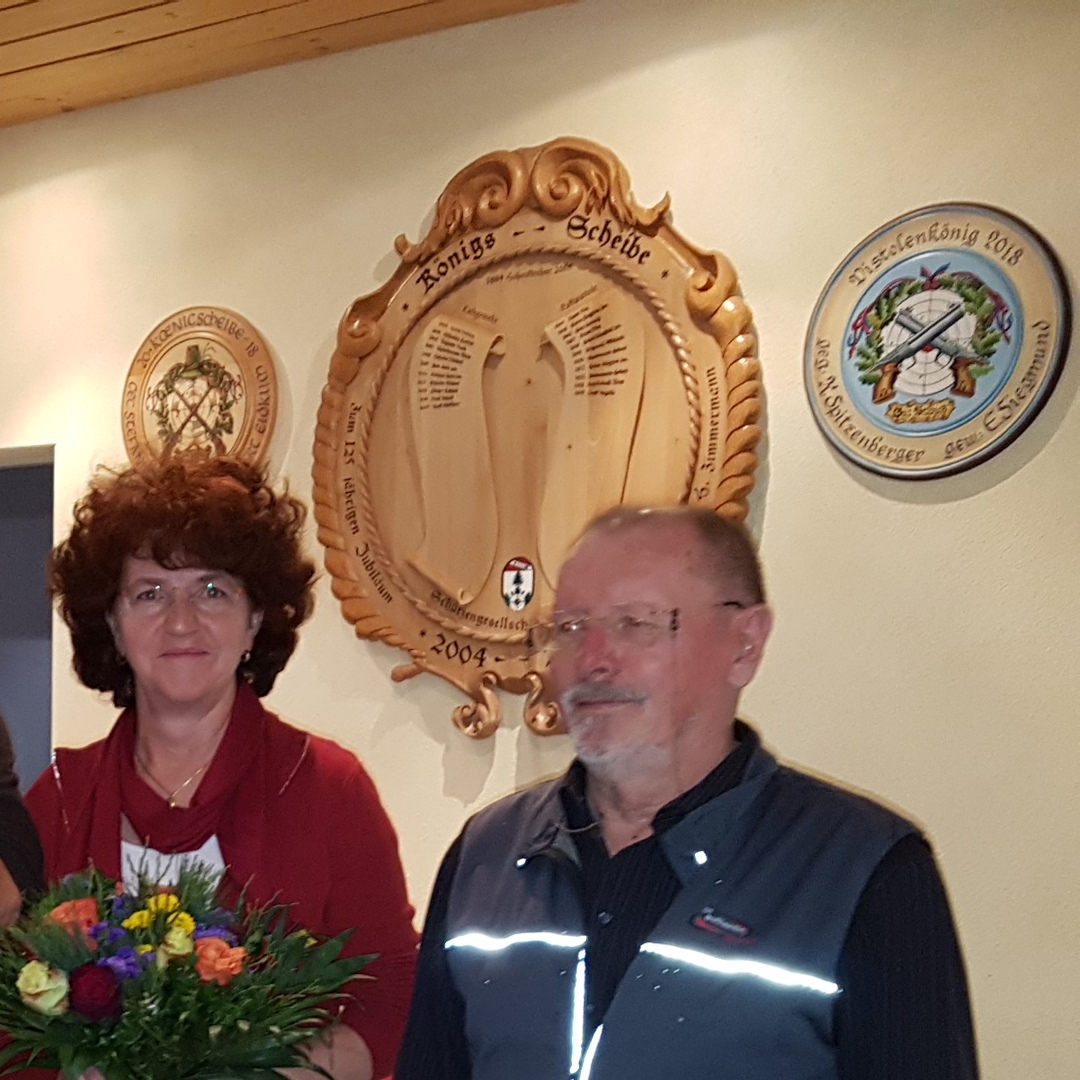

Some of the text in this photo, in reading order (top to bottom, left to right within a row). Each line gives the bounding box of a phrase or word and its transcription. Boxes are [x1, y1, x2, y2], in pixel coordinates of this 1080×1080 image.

[566, 215, 651, 265] Scheibe
[984, 229, 1024, 266] 2018
[431, 633, 487, 668] 2004
